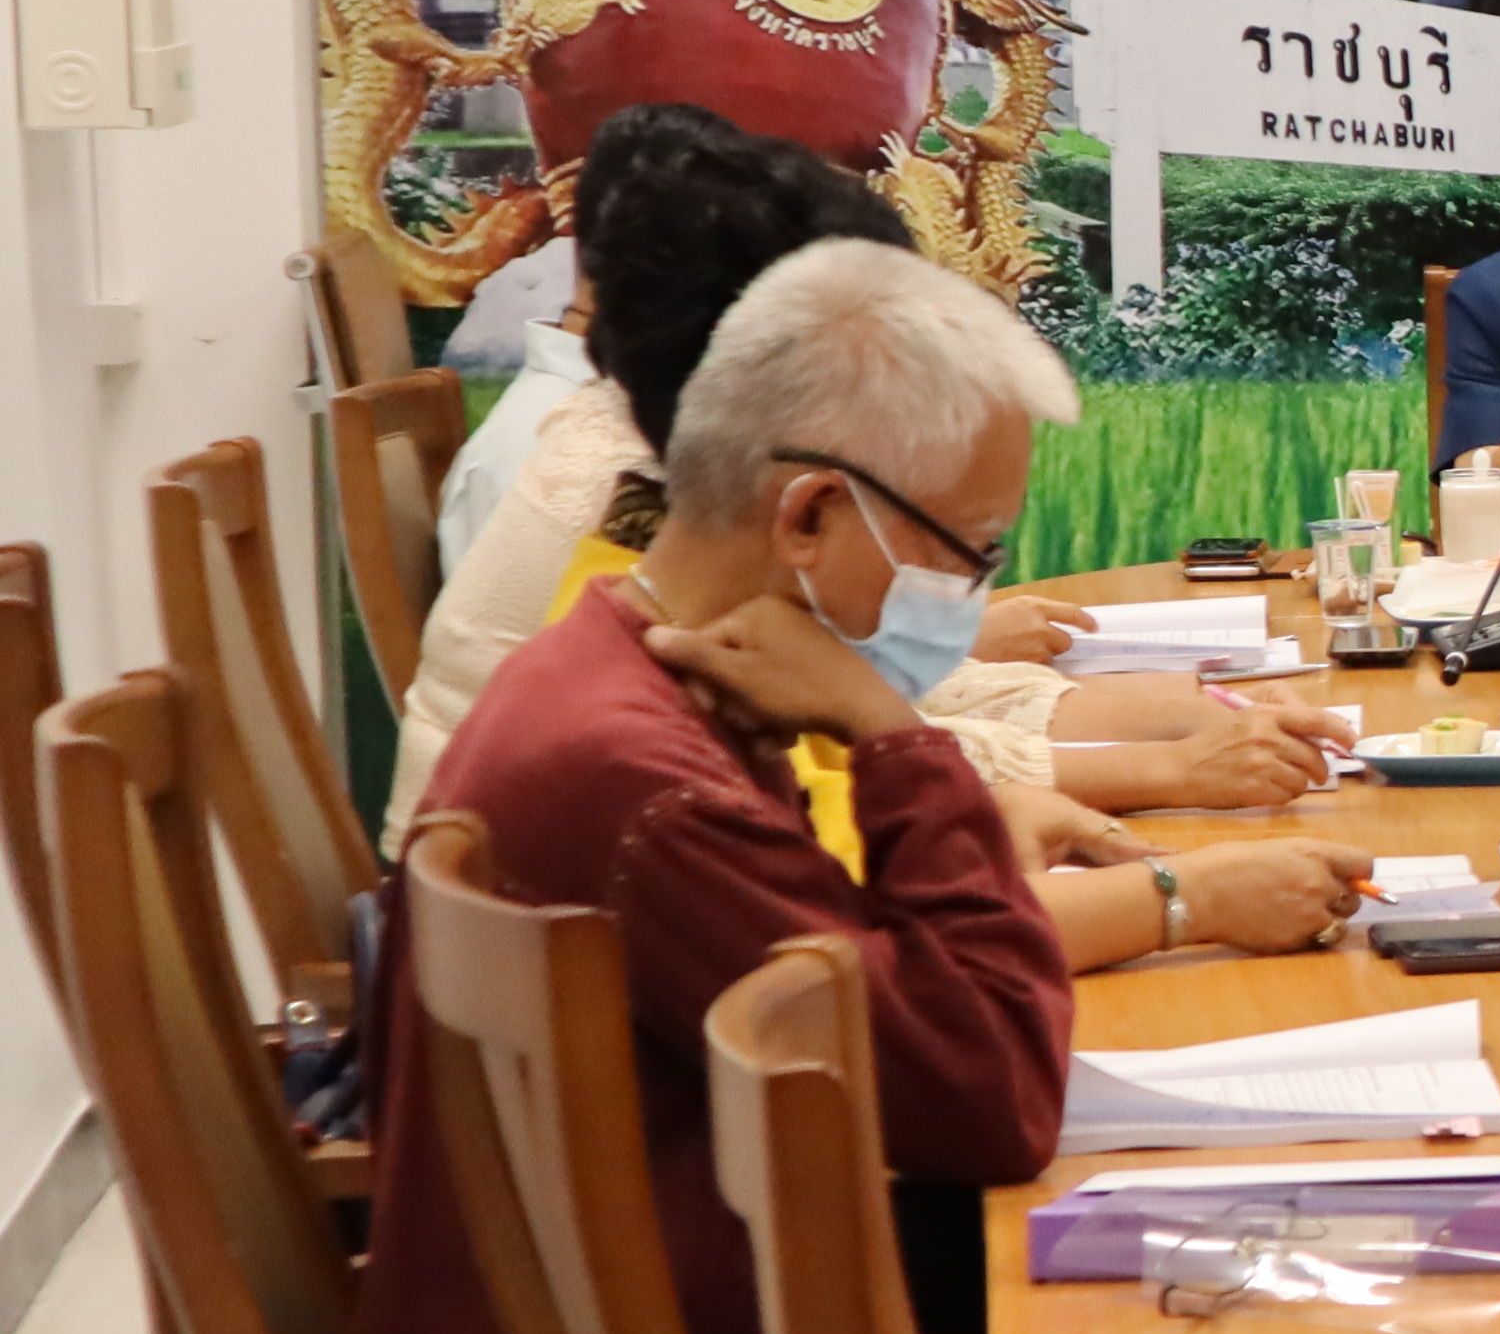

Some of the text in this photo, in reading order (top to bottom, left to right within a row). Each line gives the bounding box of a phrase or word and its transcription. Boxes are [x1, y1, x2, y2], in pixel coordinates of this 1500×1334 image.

[1241, 22, 1451, 122] ราชบุรี
[1261, 111, 1456, 154] RATCHABURI
